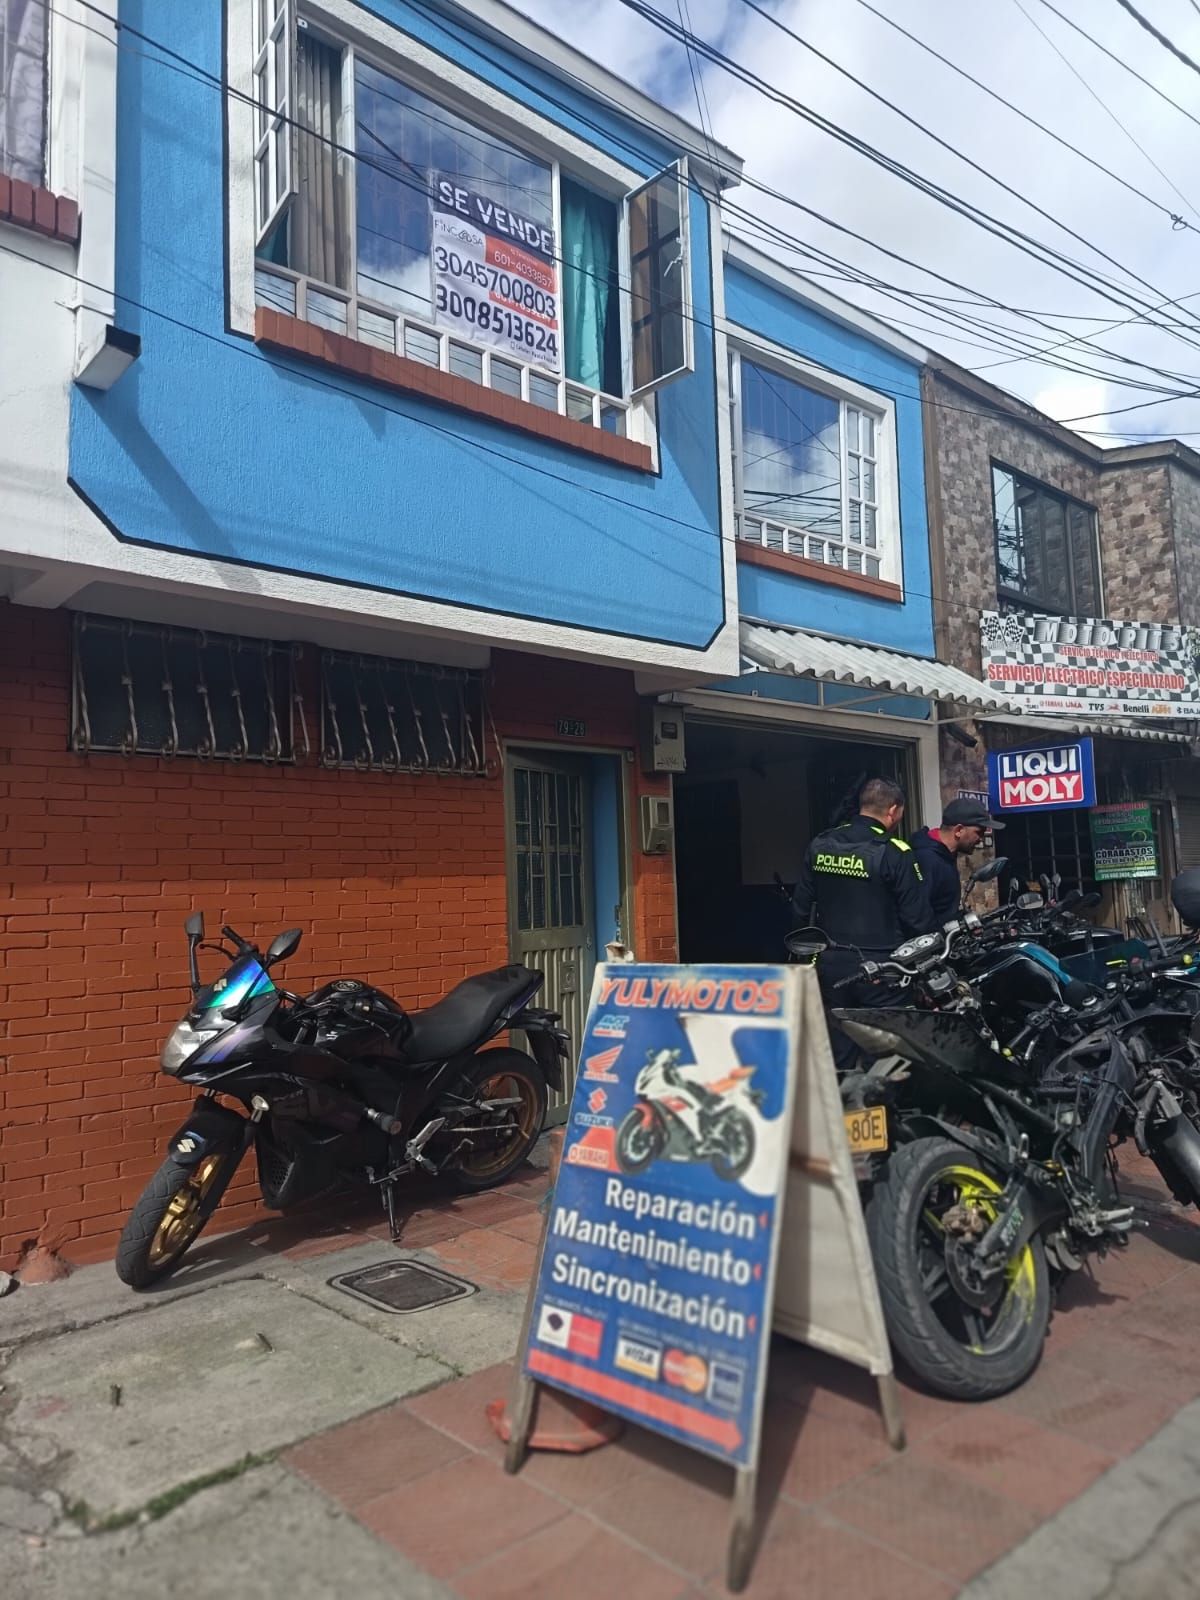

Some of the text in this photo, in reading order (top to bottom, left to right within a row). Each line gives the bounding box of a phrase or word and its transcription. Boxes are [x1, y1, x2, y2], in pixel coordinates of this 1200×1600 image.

[439, 181, 554, 256] SE VENDE
[435, 247, 556, 320] 3045700803
[436, 284, 558, 357] 3008513624
[1036, 620, 1110, 646] MOTO
[988, 664, 1043, 683] SERVICIO
[1107, 671, 1185, 690] ESPECIALIZADO
[1088, 703, 1104, 711] TVS
[1123, 703, 1150, 713] Benelli
[1003, 748, 1077, 778] LIQUI
[1004, 775, 1080, 804] MOLY
[816, 854, 865, 871] POLICÍA
[598, 976, 785, 1013] YULYMOTOS
[604, 1178, 756, 1240] Reparación
[553, 1208, 751, 1285] Mantenimiento
[551, 1253, 745, 1340] Sincronización
